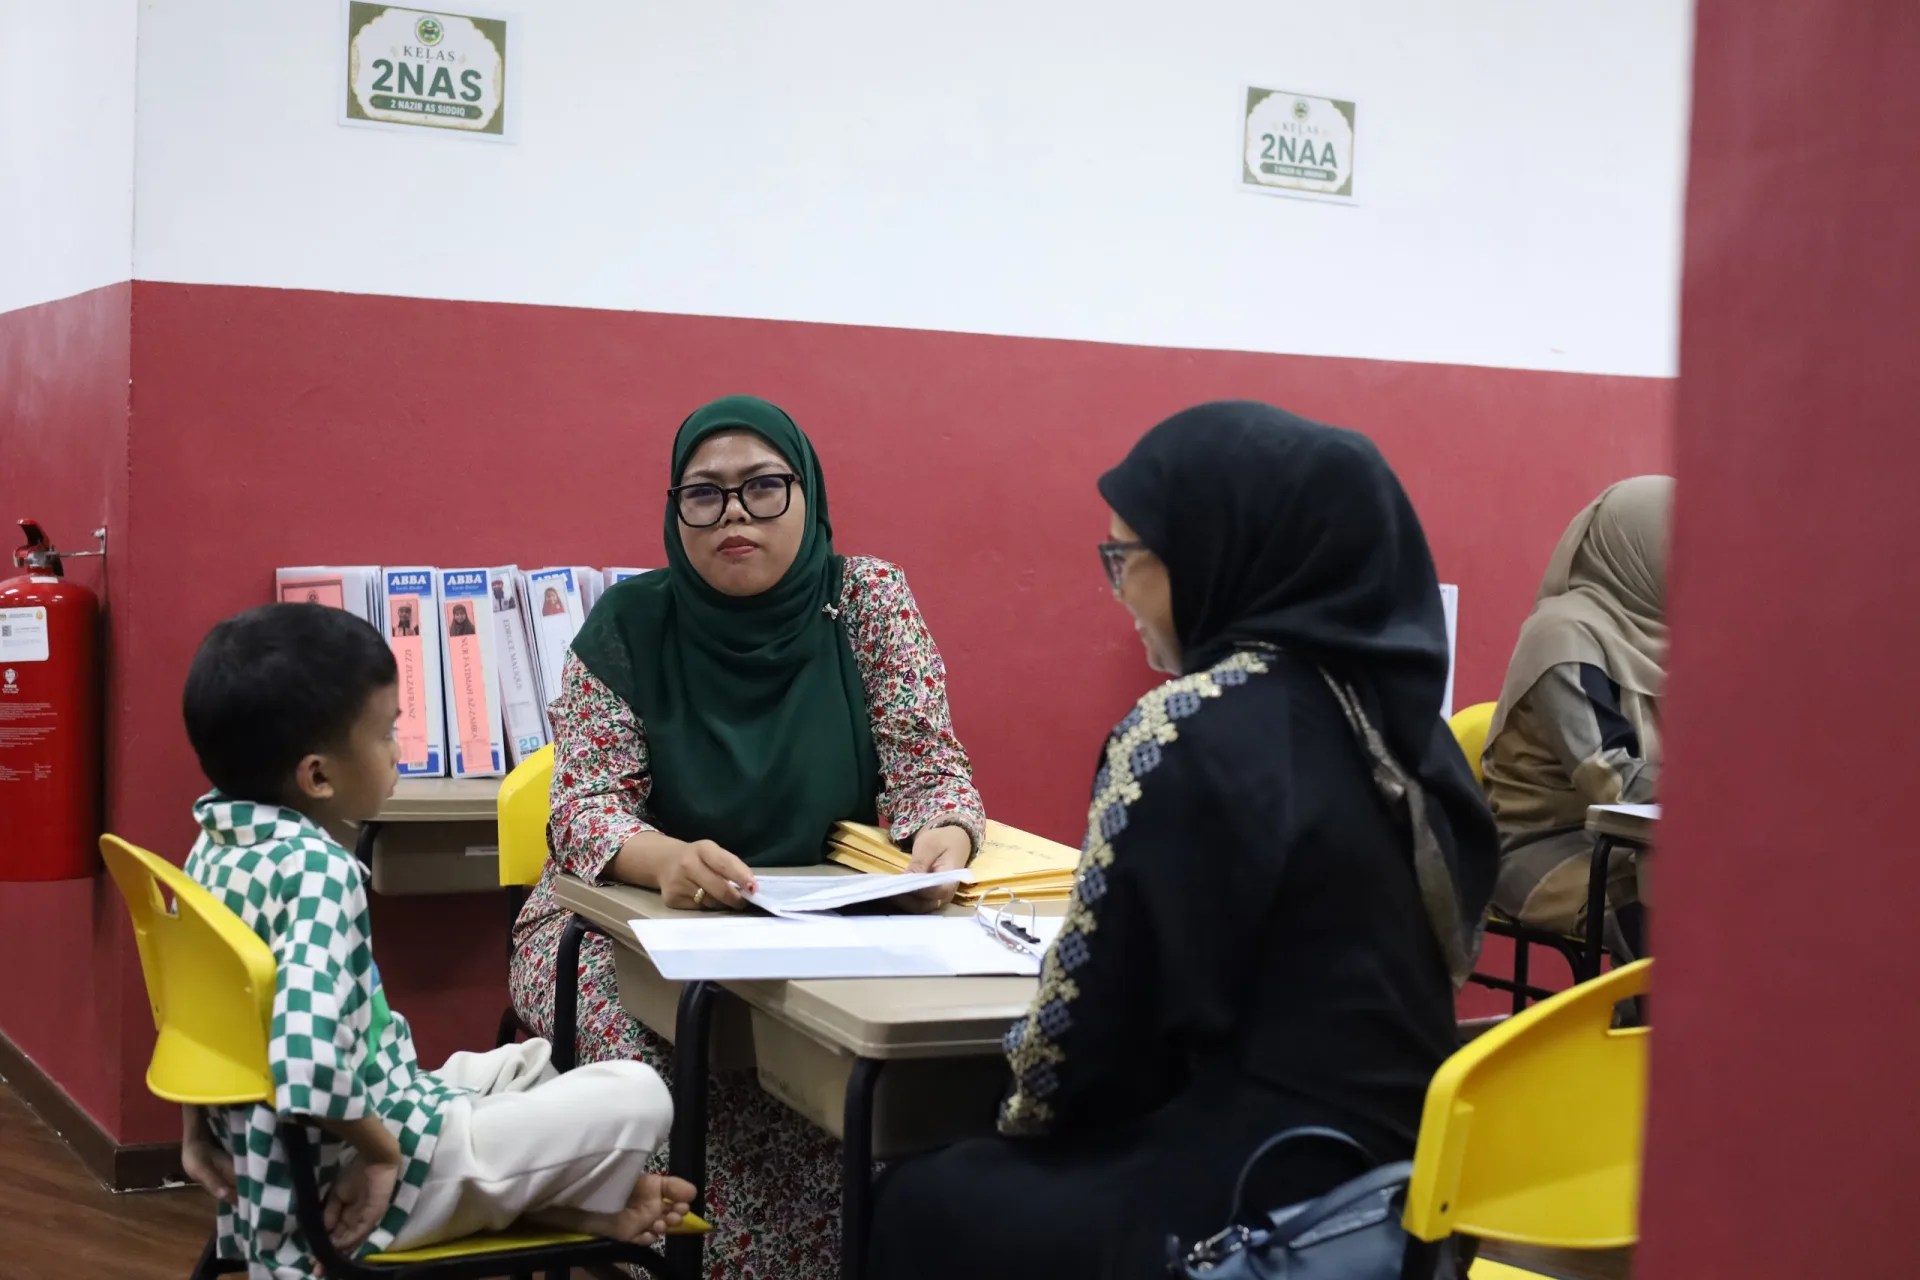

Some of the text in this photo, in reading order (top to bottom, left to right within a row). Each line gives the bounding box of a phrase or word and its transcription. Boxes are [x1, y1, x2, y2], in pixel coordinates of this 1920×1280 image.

[403, 45, 456, 62] KELAS
[371, 58, 483, 102] 2NAS
[390, 99, 466, 117] 2 NAZIR AS SIDDIQ
[1260, 133, 1338, 169] 2NAA
[391, 574, 427, 586] ABBA
[447, 573, 483, 586] ABBA
[462, 656, 473, 695] FATIMAH
